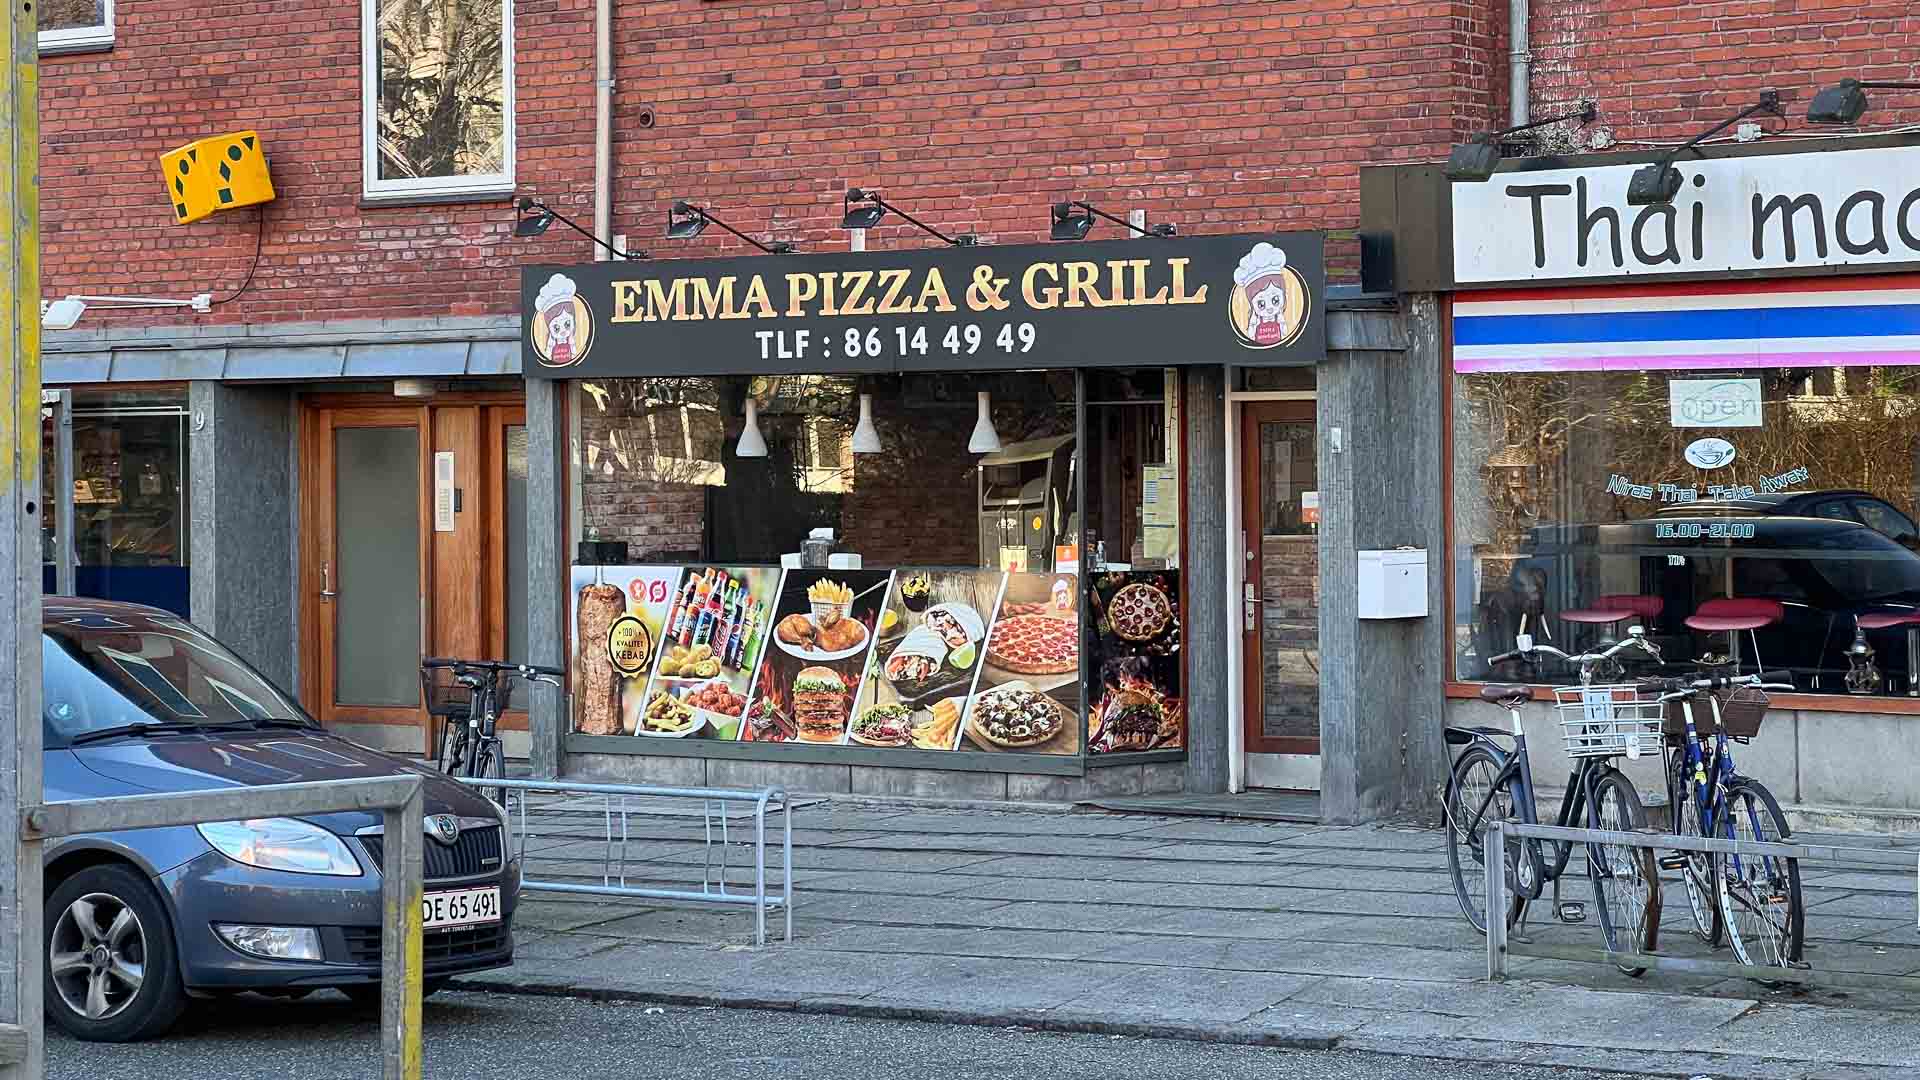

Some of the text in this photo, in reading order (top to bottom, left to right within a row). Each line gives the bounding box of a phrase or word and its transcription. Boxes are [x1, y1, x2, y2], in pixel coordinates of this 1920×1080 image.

[1506, 176, 1706, 269] Thai
[610, 257, 1209, 323] EMMA PIZZA & GRILL
[755, 329, 811, 359] TLF
[844, 327, 882, 357] 86
[895, 326, 929, 355] 14
[942, 323, 982, 354] 49
[996, 322, 1036, 353] 49
[1658, 482, 1698, 503] Thai
[1707, 483, 1756, 504] Take
[1759, 466, 1809, 495] Away
[1655, 523, 1755, 538] 16.00-21.00
[615, 650, 645, 660] KEBAB
[449, 895, 468, 920] 65
[473, 892, 497, 917] 491
